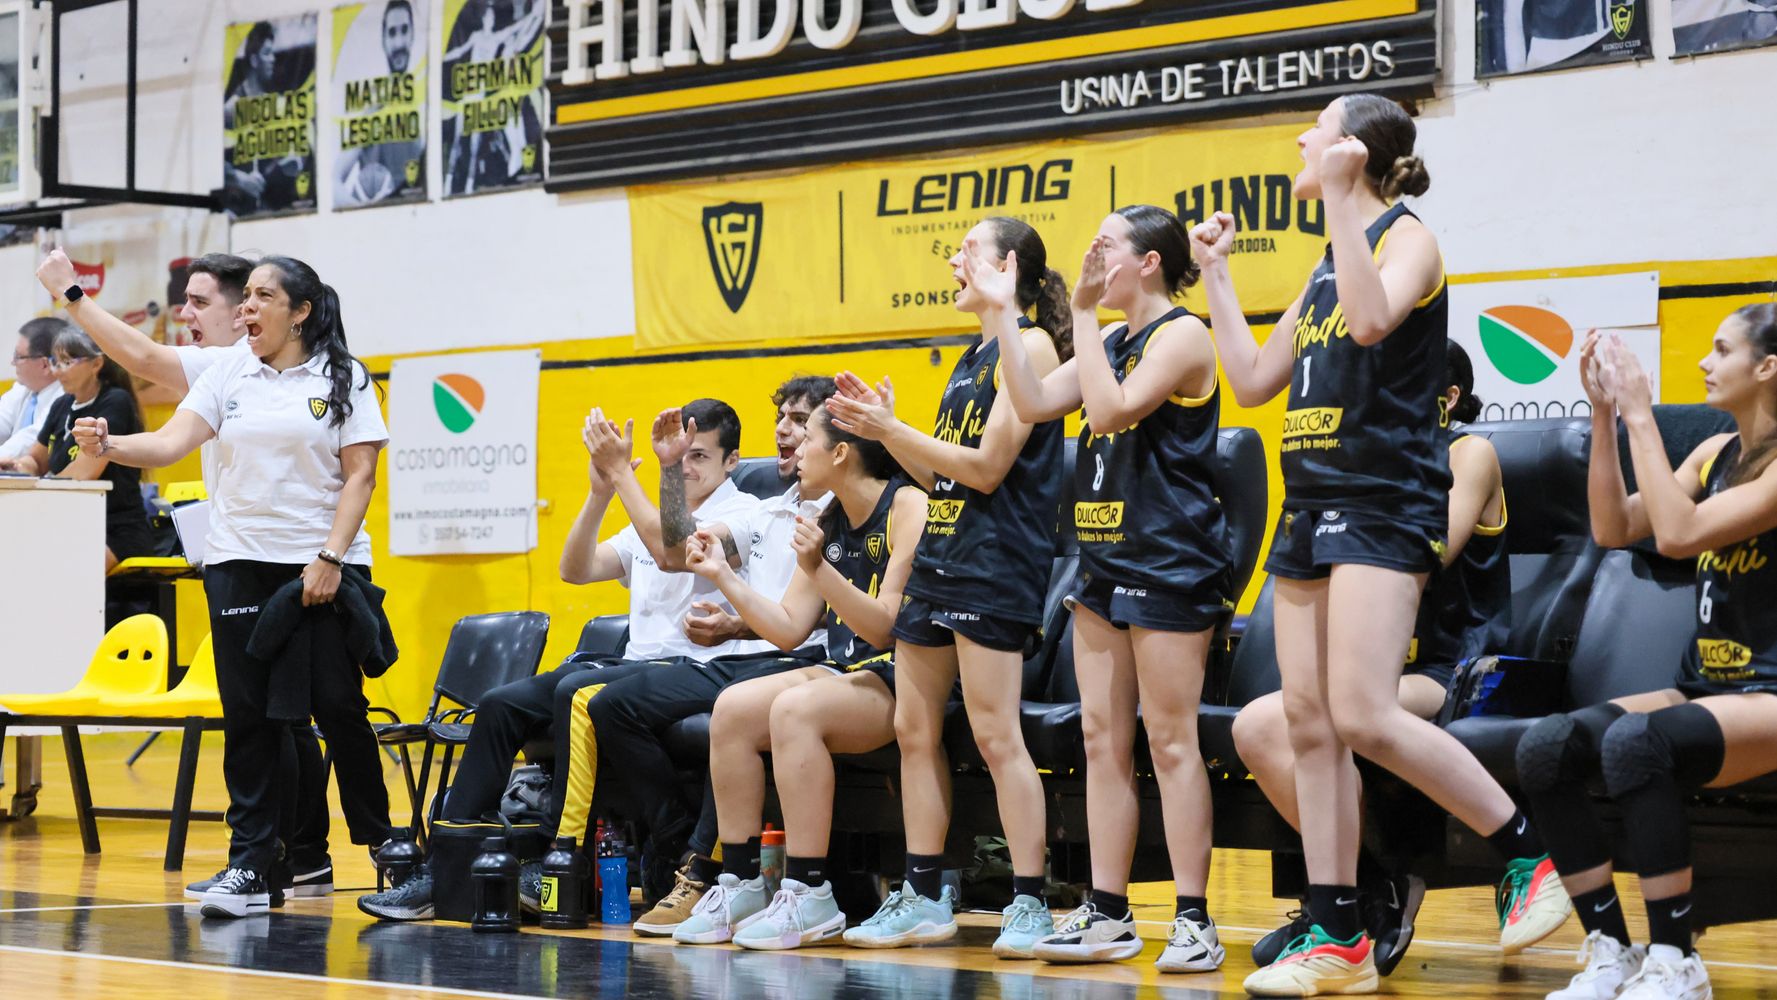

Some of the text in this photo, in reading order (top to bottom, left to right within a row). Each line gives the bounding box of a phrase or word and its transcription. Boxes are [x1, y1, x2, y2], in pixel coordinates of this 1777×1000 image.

[1061, 41, 1396, 115] USINA DE TALENTOS
[235, 124, 308, 162] AGUIRRE
[340, 110, 419, 149] LESCANO
[877, 159, 1073, 217] LENING
[1229, 237, 1276, 254] ORDOBA
[1301, 355, 1312, 398] 1
[1283, 410, 1333, 433] DULCOR
[394, 443, 528, 474] costamagna
[1077, 504, 1119, 526] DULCOR
[222, 605, 259, 617] LENING
[1700, 580, 1713, 624] 6
